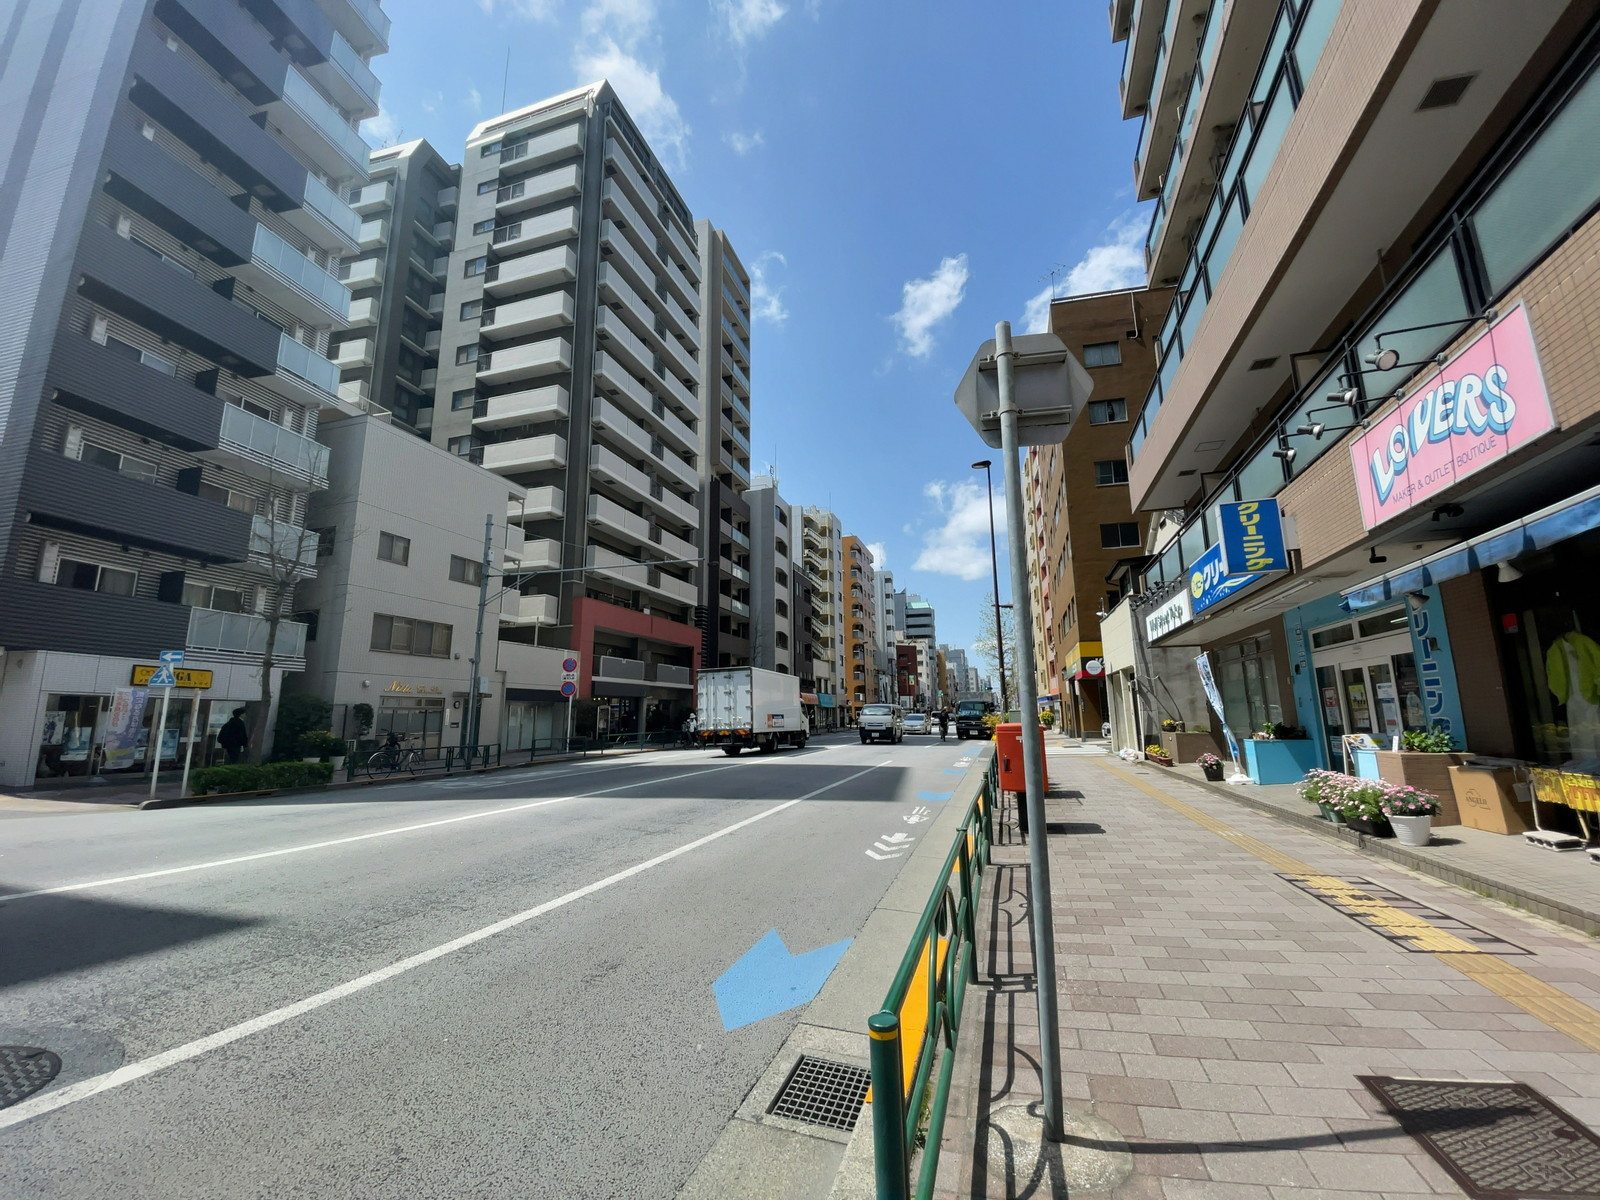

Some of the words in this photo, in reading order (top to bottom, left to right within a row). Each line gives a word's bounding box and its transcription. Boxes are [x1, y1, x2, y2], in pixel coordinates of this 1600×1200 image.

[1370, 363, 1516, 506] LOVERS
[1392, 483, 1417, 504] MAKER
[1417, 479, 1424, 490] &
[1424, 460, 1455, 486] OUTLET
[1456, 435, 1497, 468] BOUTIQUE
[1237, 502, 1274, 571] クリーニング
